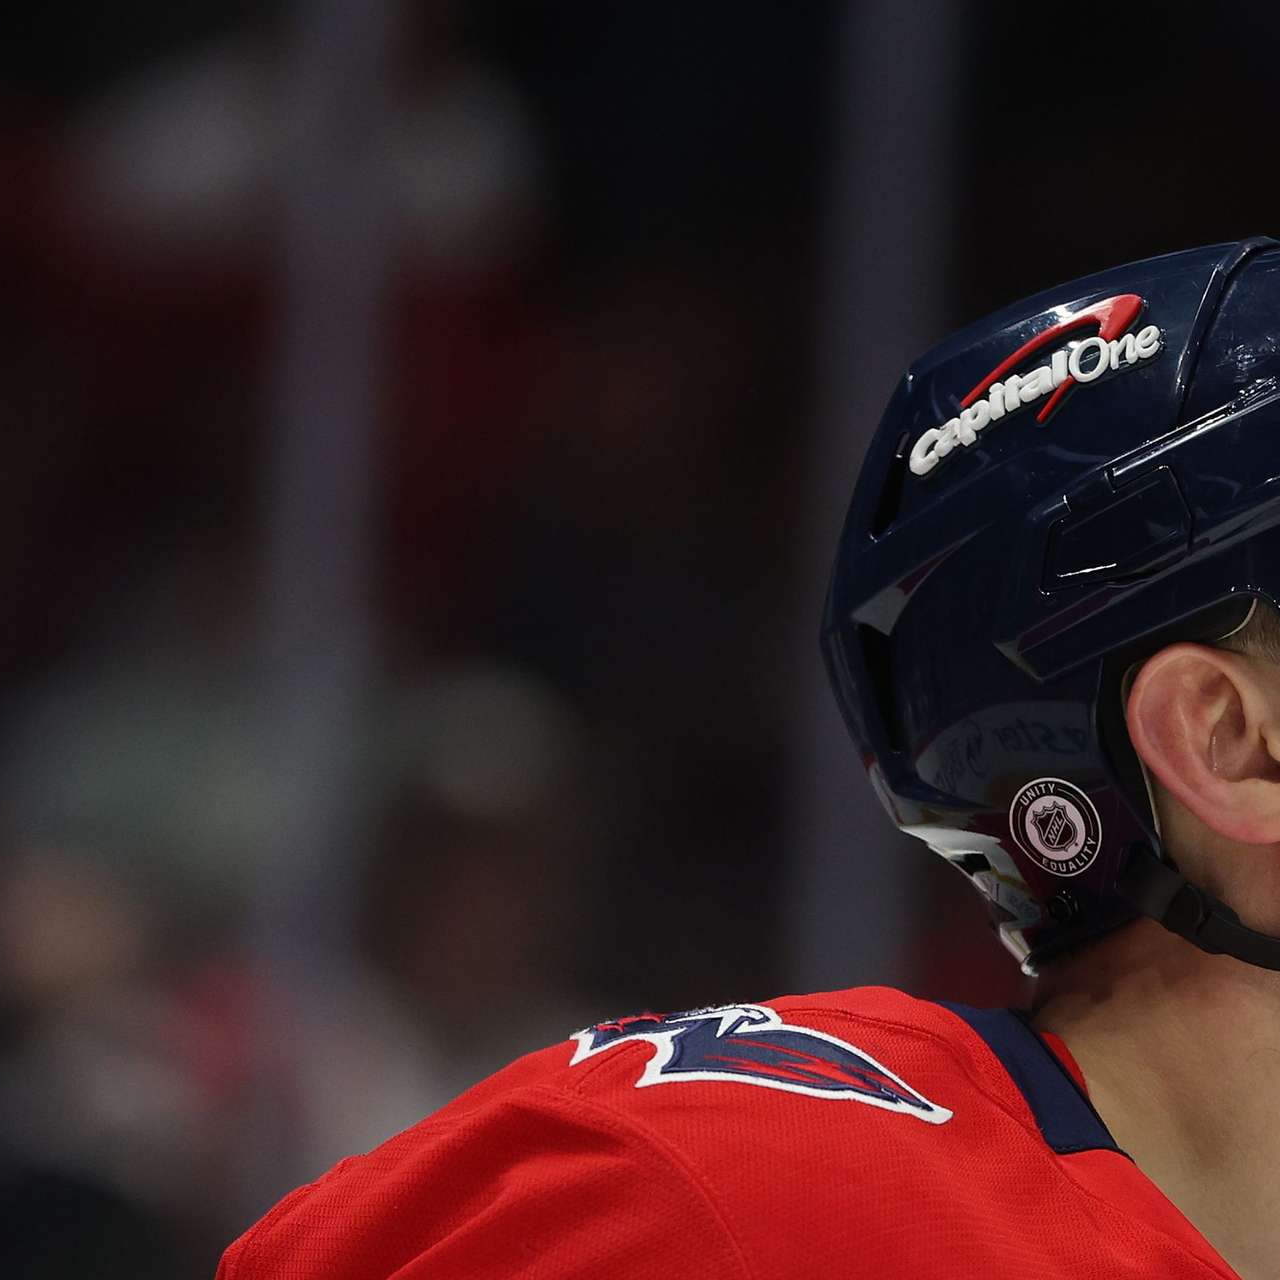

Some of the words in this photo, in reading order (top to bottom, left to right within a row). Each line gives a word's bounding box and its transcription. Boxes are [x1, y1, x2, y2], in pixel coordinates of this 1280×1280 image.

[1020, 783, 1056, 806] UNITY
[1047, 815, 1064, 844] NHL
[1042, 837, 1097, 873] EQUALITY
